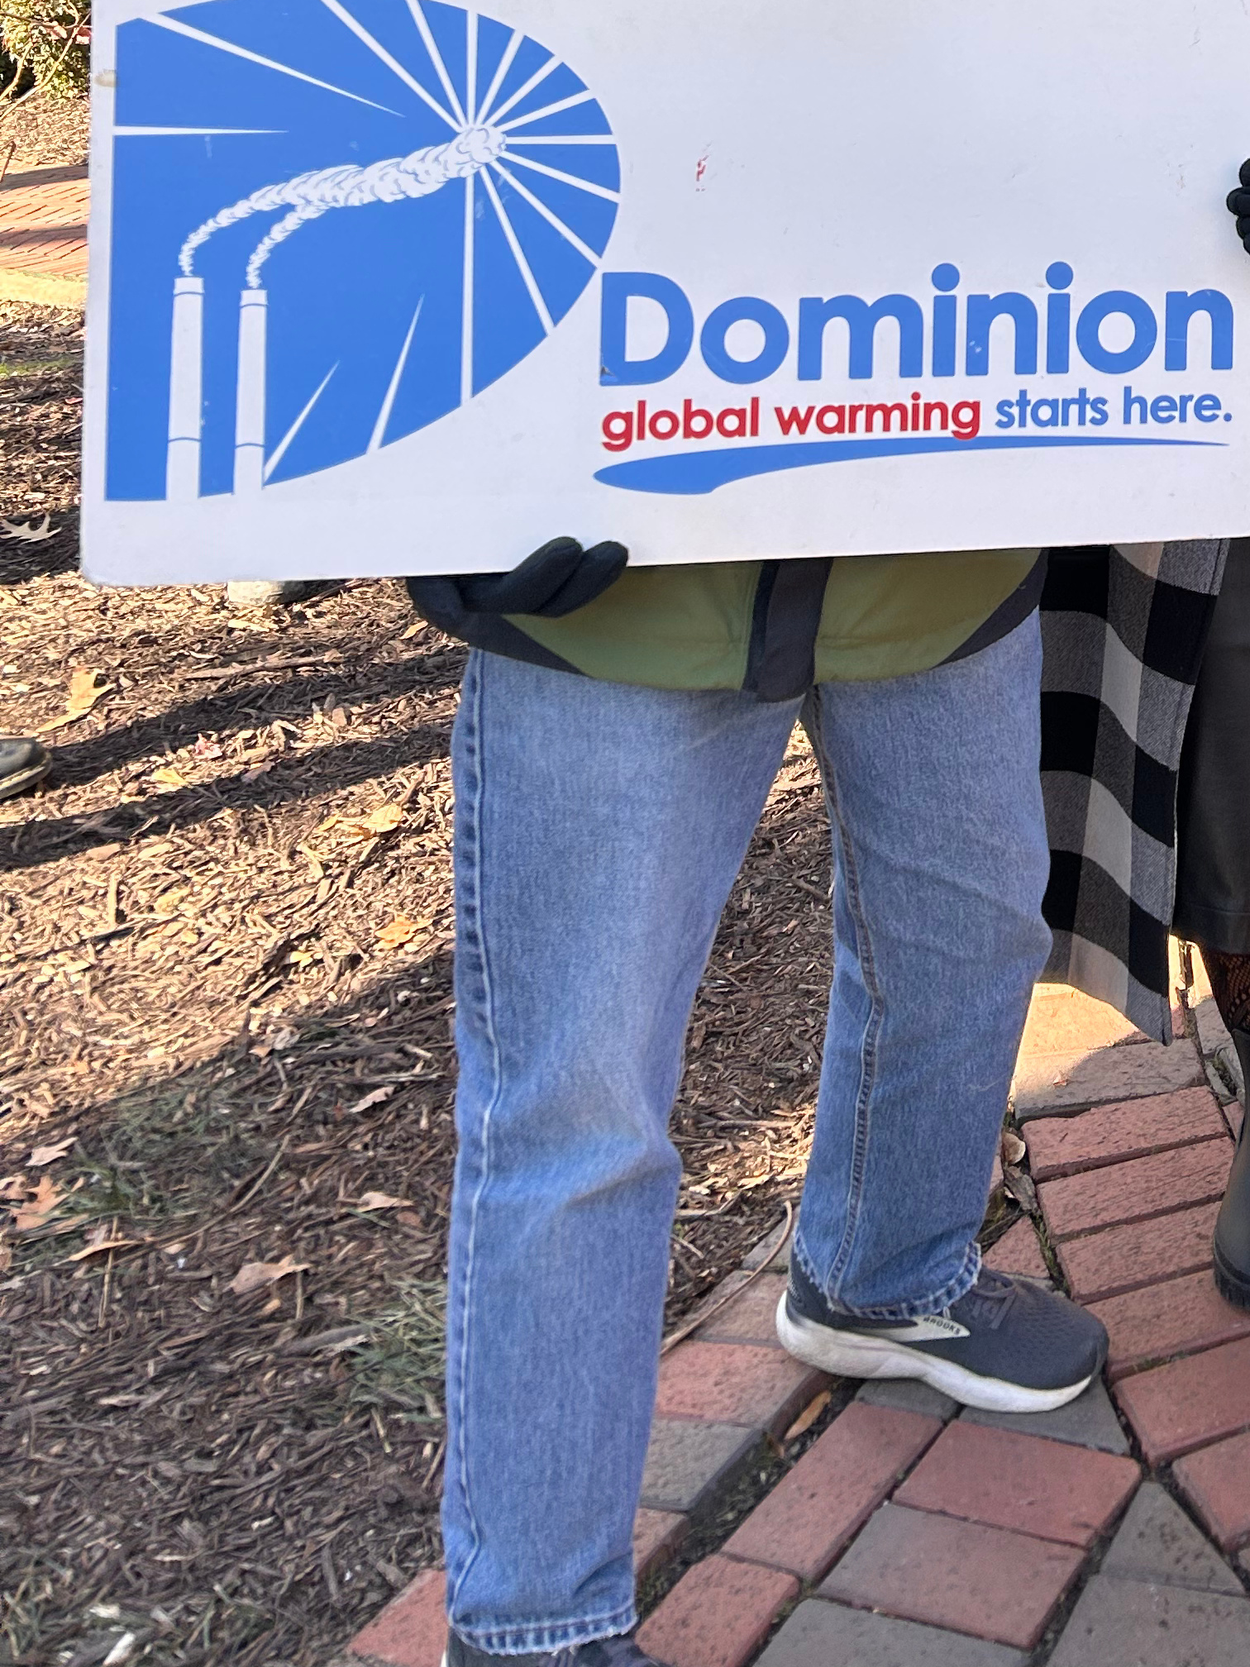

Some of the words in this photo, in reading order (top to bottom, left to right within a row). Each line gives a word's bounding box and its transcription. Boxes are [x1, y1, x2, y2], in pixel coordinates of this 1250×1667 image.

[600, 262, 1233, 386] Dominion
[602, 397, 759, 452] global
[774, 392, 982, 441] warming
[995, 388, 1108, 429] starts
[1123, 386, 1233, 425] here.
